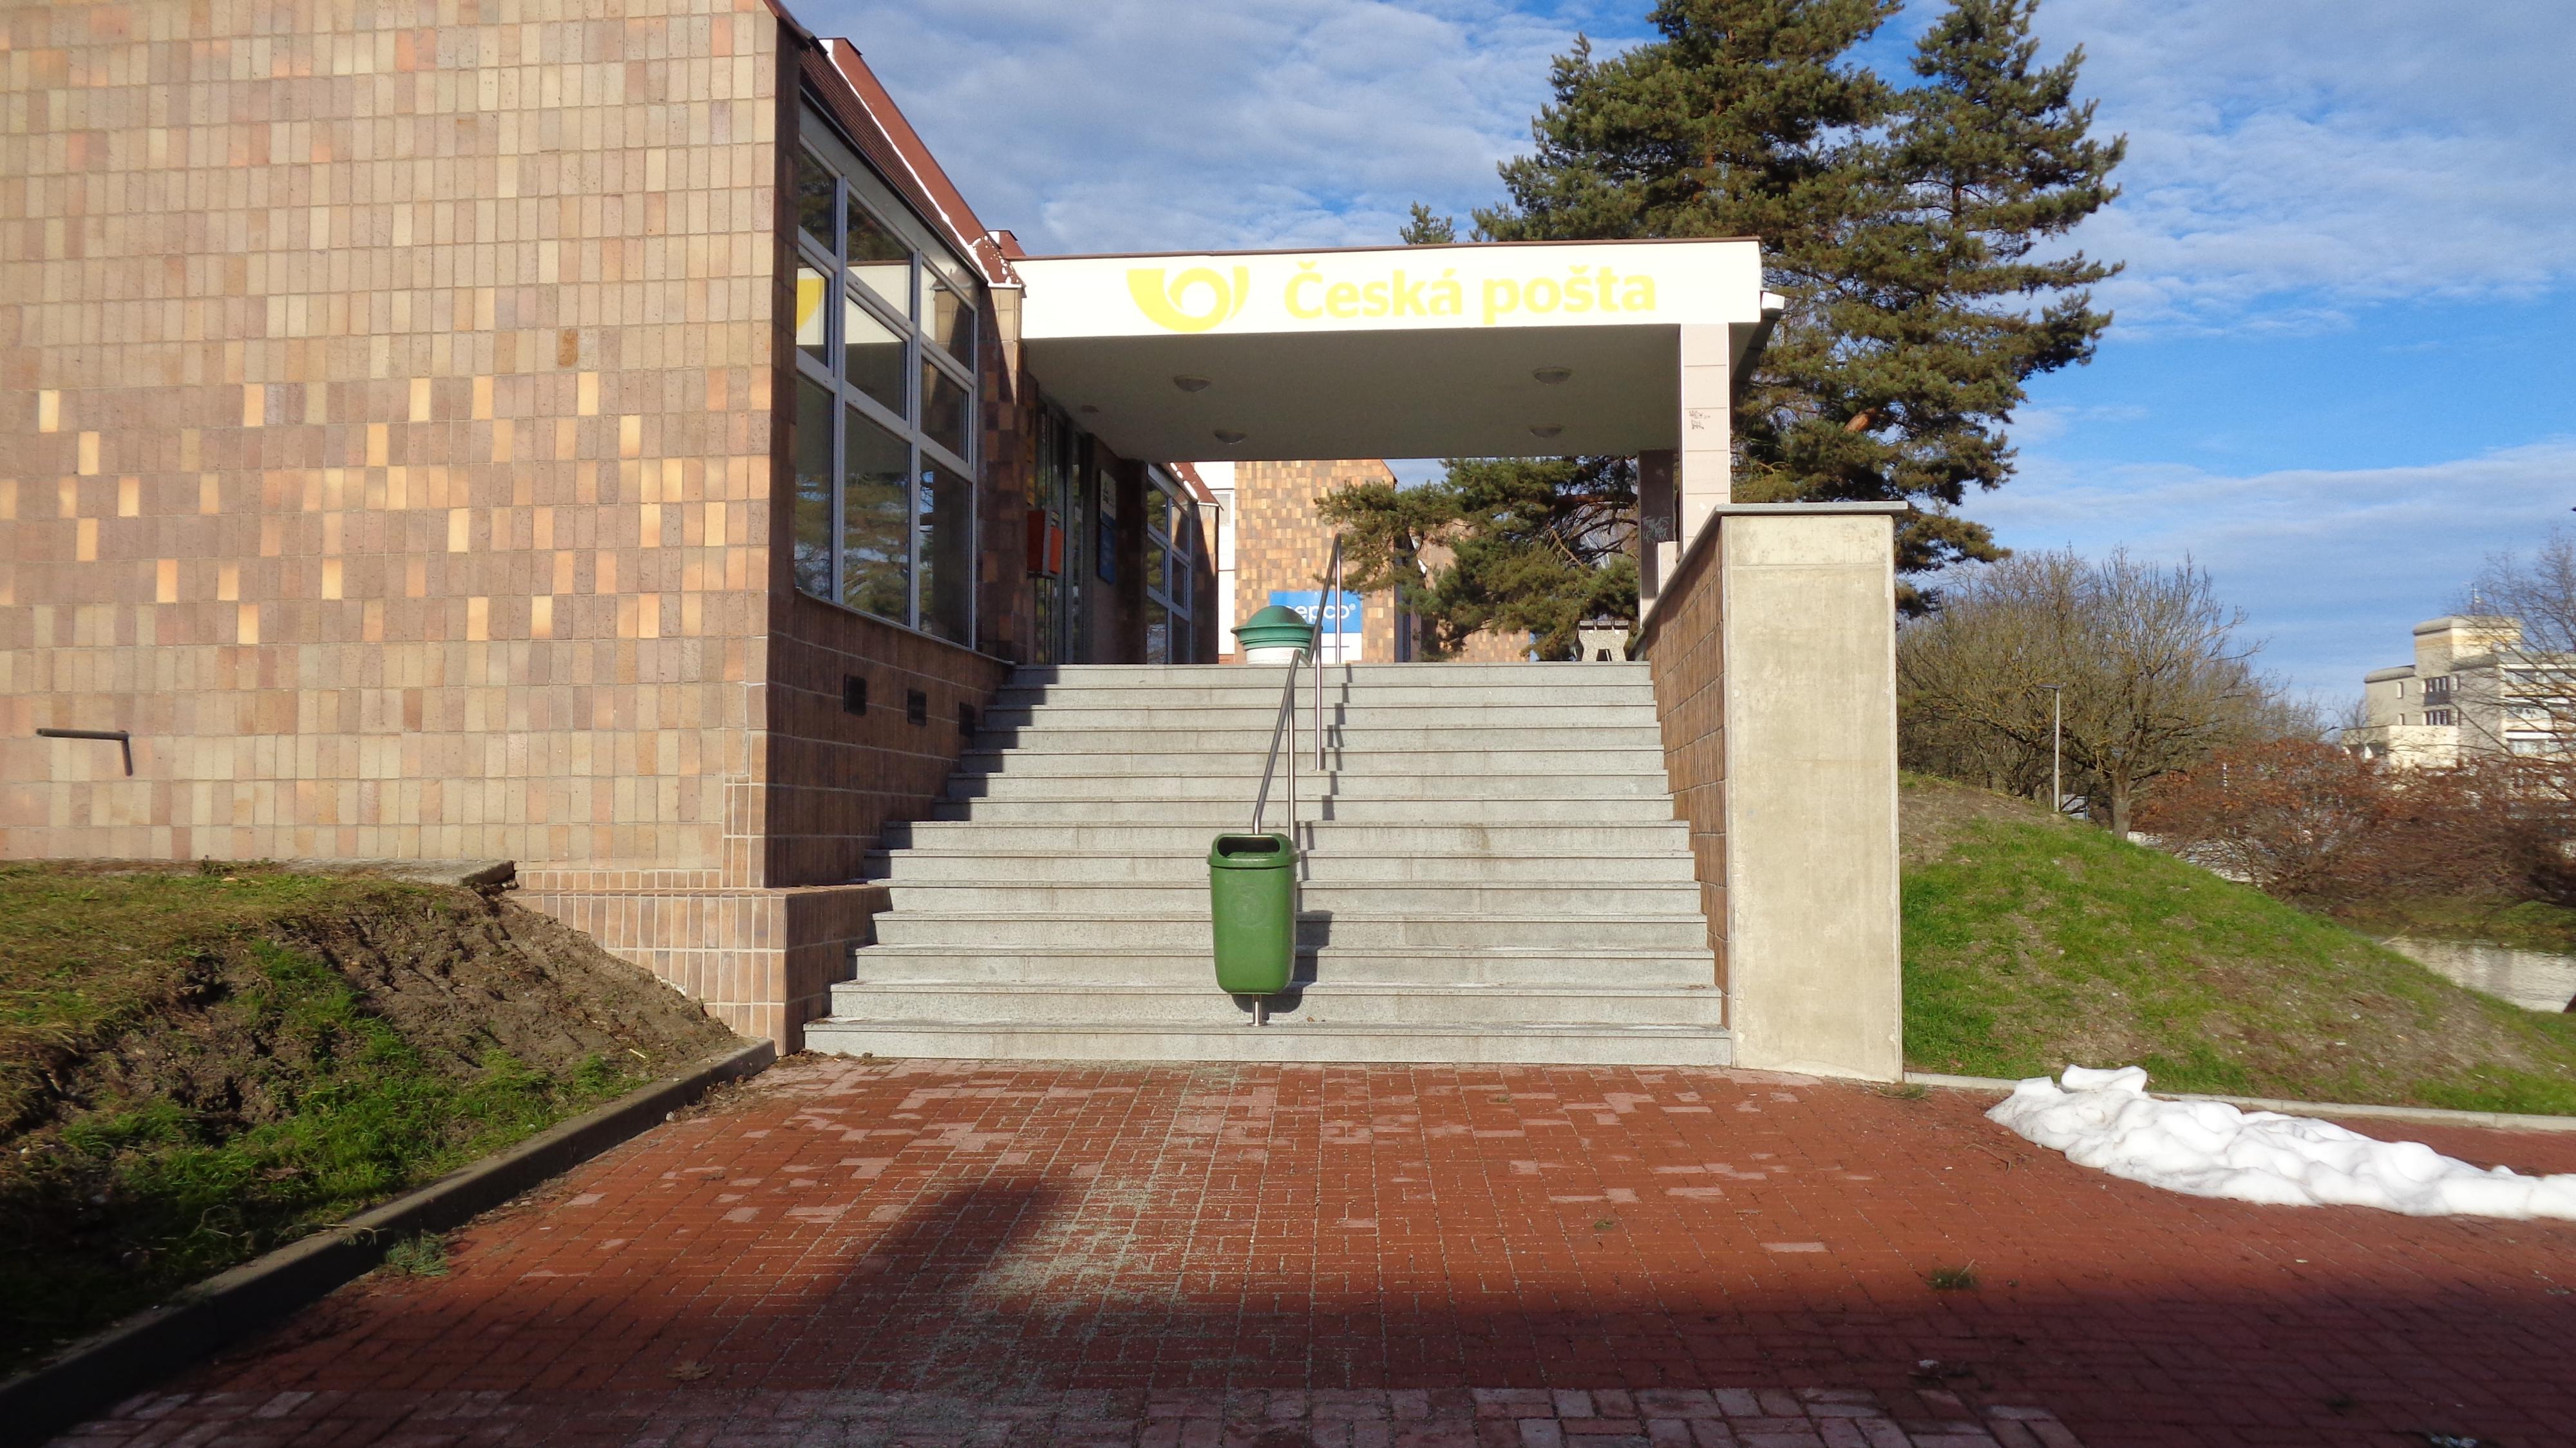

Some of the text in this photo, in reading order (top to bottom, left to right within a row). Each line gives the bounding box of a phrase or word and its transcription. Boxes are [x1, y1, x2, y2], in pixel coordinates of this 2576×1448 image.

[1283, 260, 1657, 326] Česká pošta
[1285, 604, 1350, 623] epco
